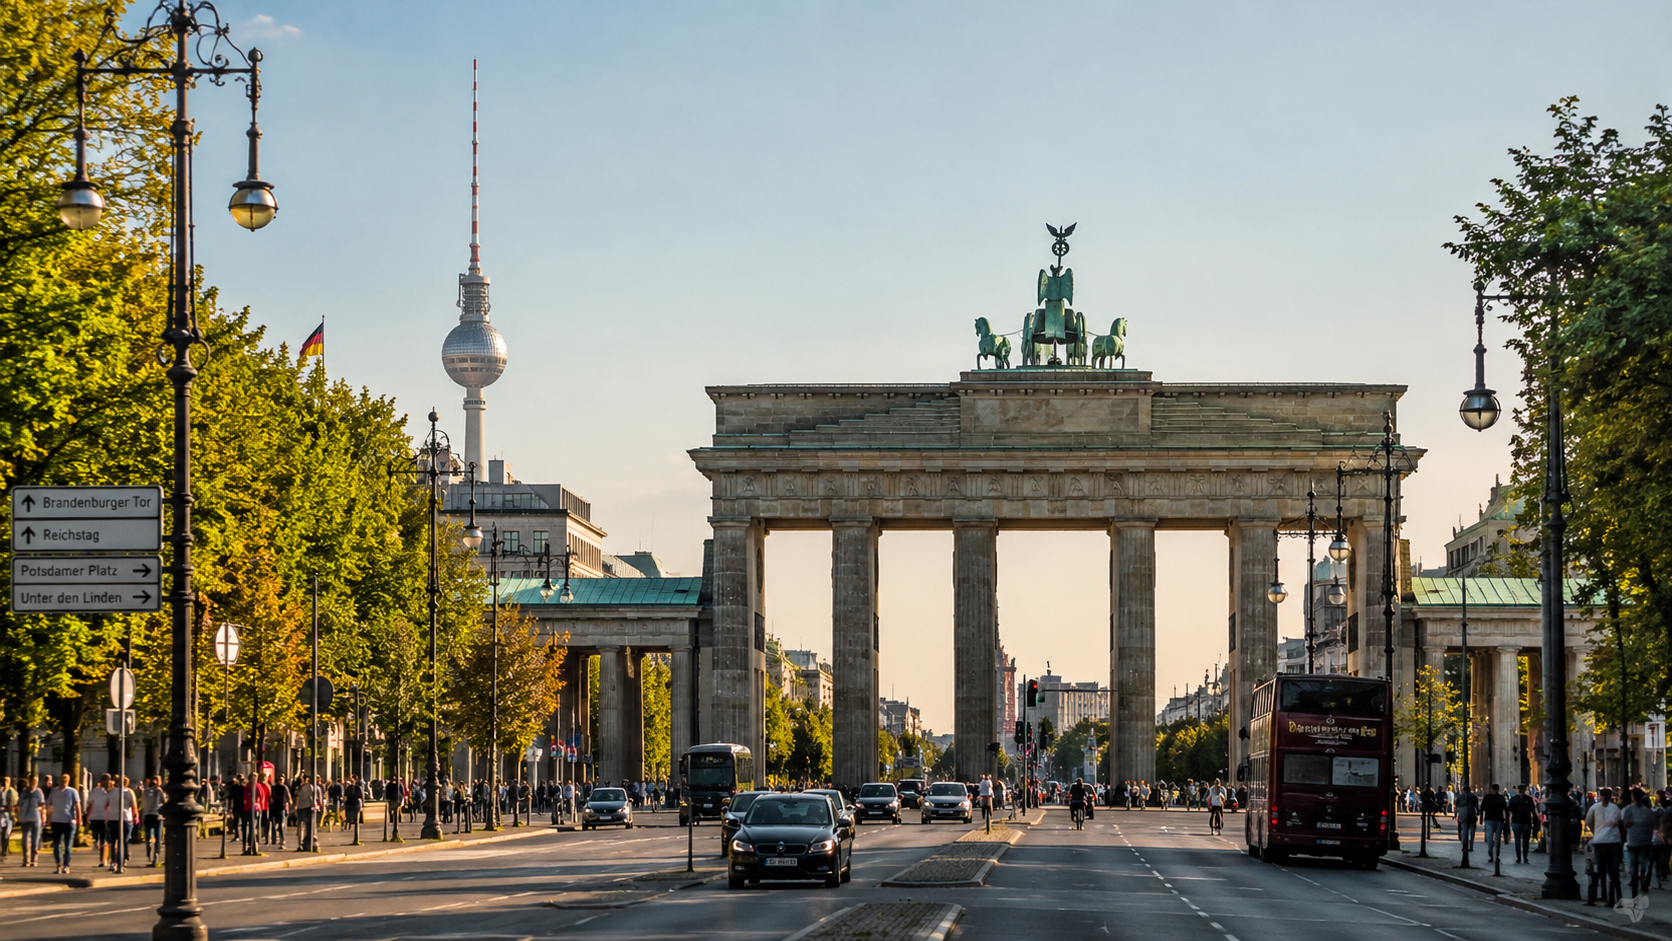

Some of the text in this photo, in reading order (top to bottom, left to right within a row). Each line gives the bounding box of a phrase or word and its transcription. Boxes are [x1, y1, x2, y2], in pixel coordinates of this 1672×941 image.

[43, 496, 151, 510] Brandenburger Tor
[43, 529, 99, 543] Reichstag
[21, 565, 117, 576] Potsdamer Platz
[20, 592, 121, 604] Unter den Linden
